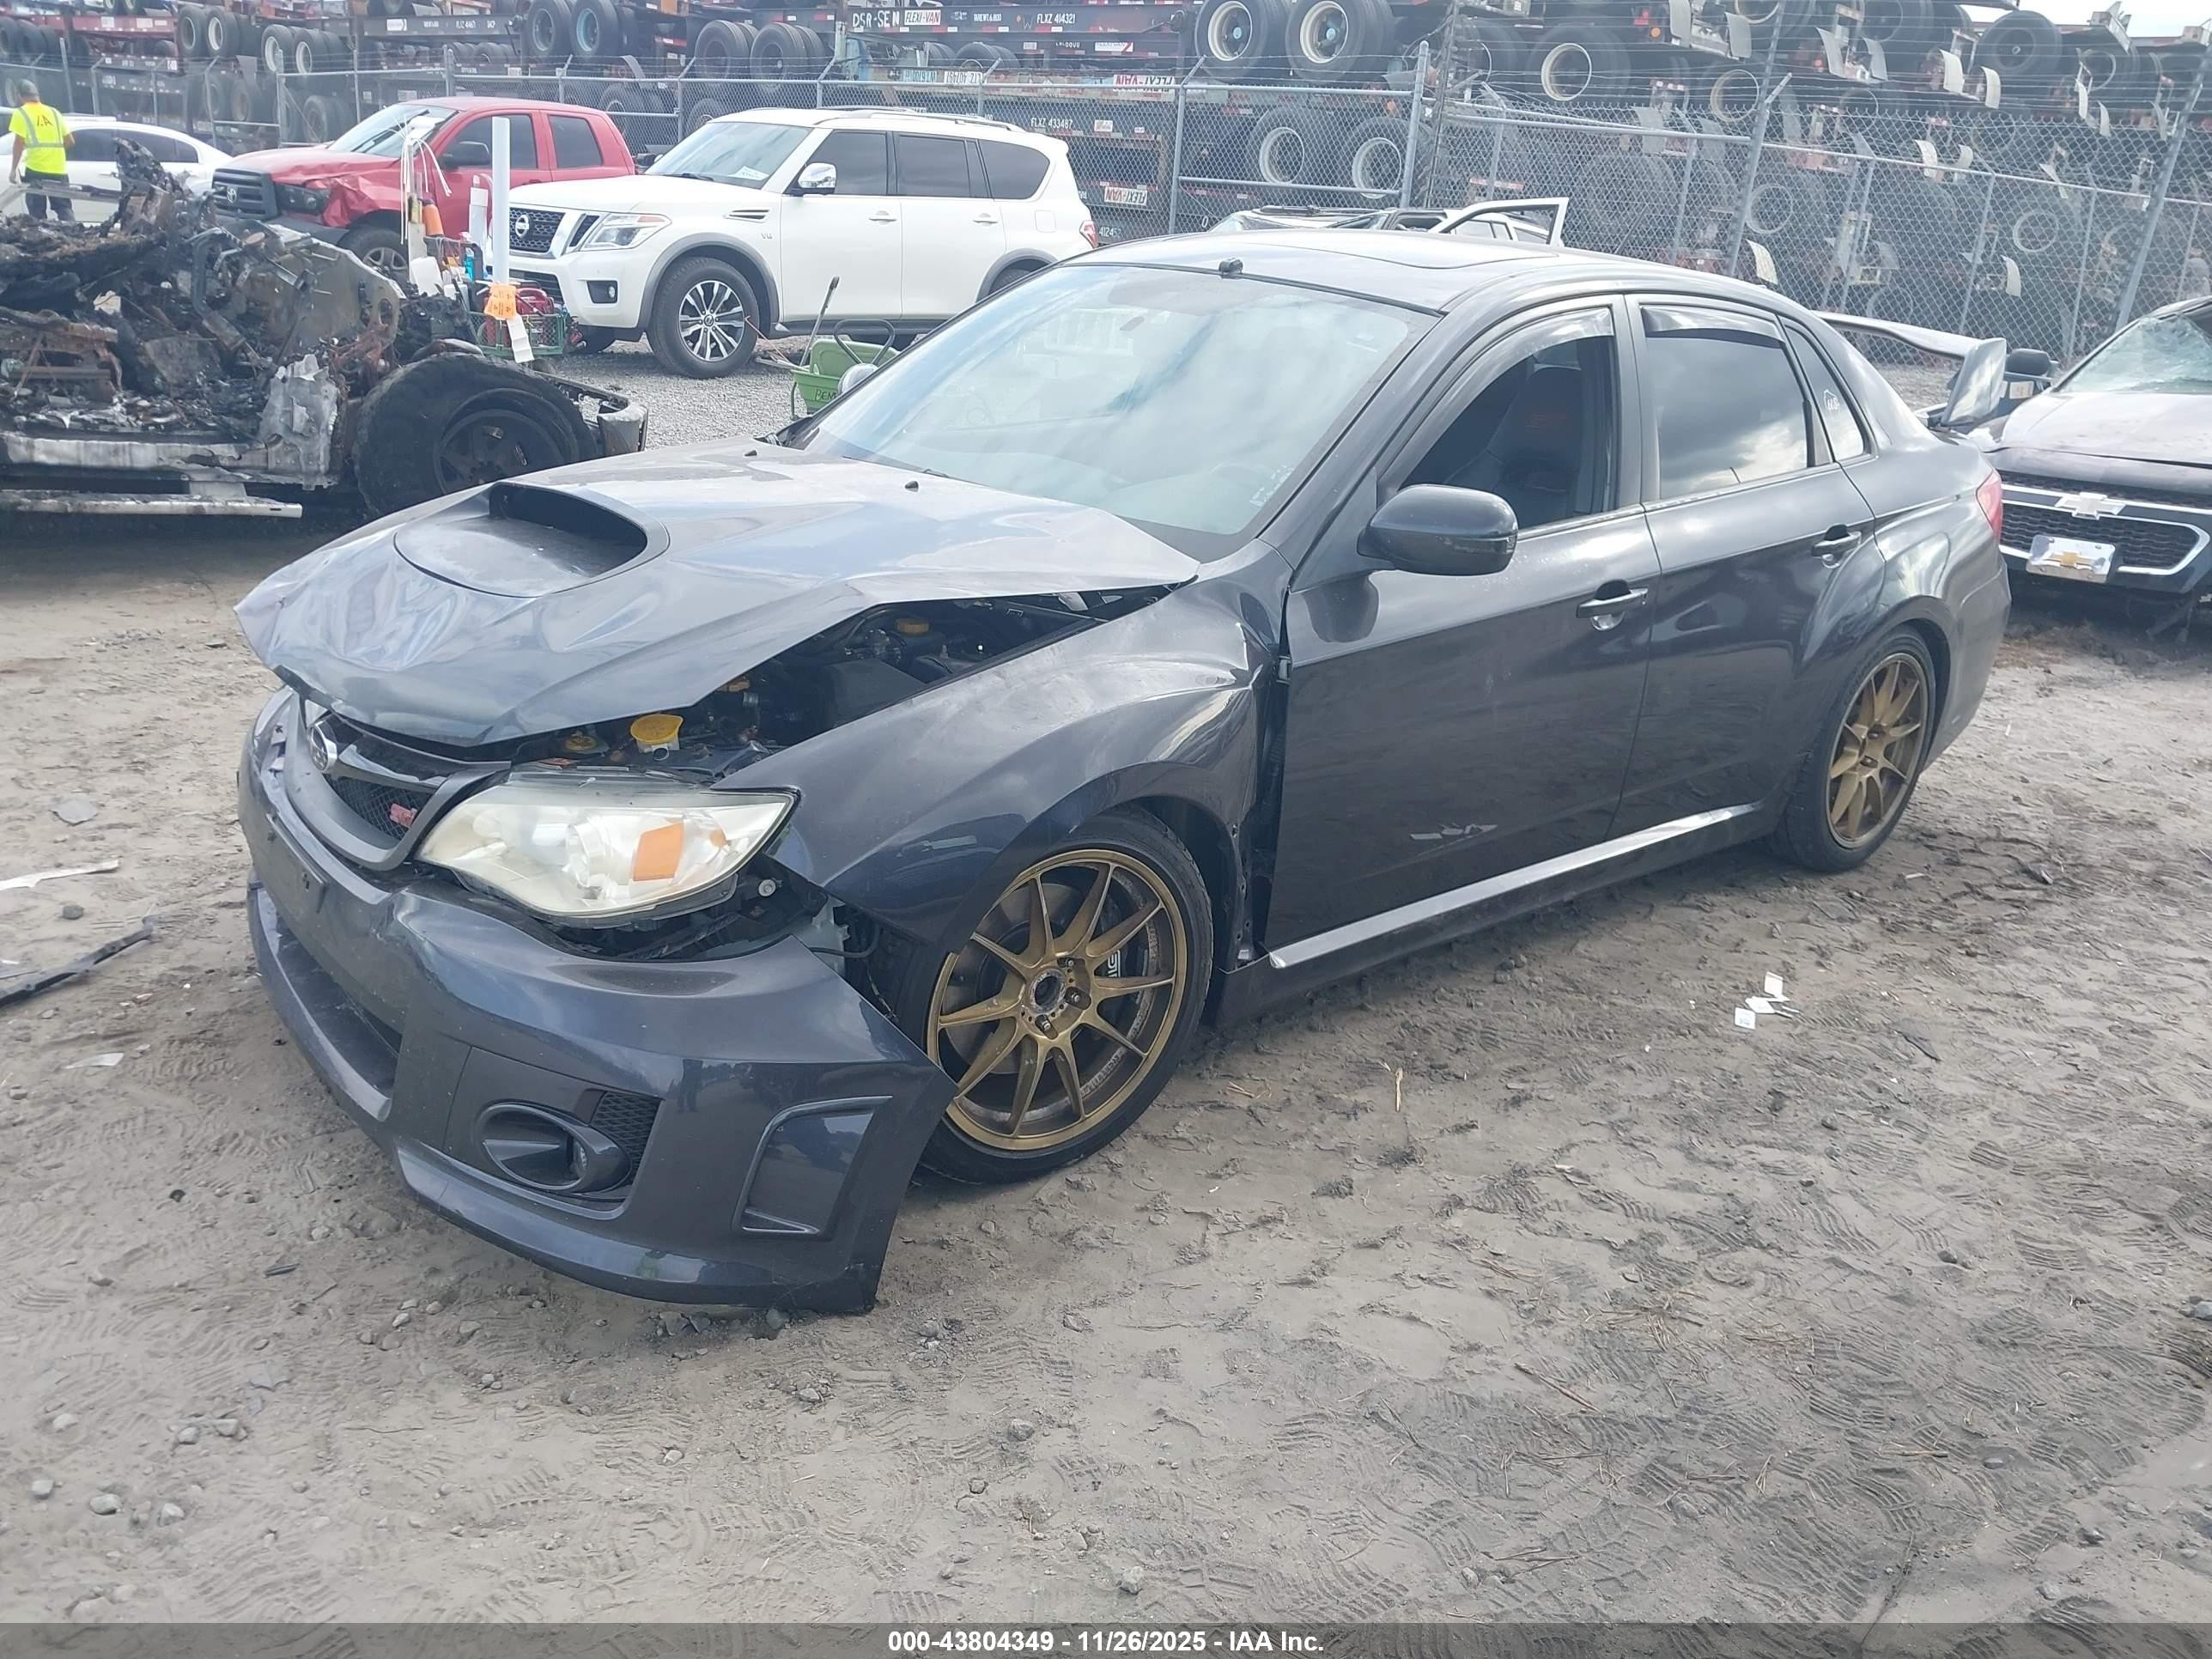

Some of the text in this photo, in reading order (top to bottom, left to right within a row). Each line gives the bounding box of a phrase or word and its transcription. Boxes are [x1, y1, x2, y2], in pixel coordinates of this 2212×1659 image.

[906, 11, 940, 24] FLEXI-VAN
[1036, 13, 1053, 24] FLXZ
[1030, 117, 1073, 130] FLXZ 433487
